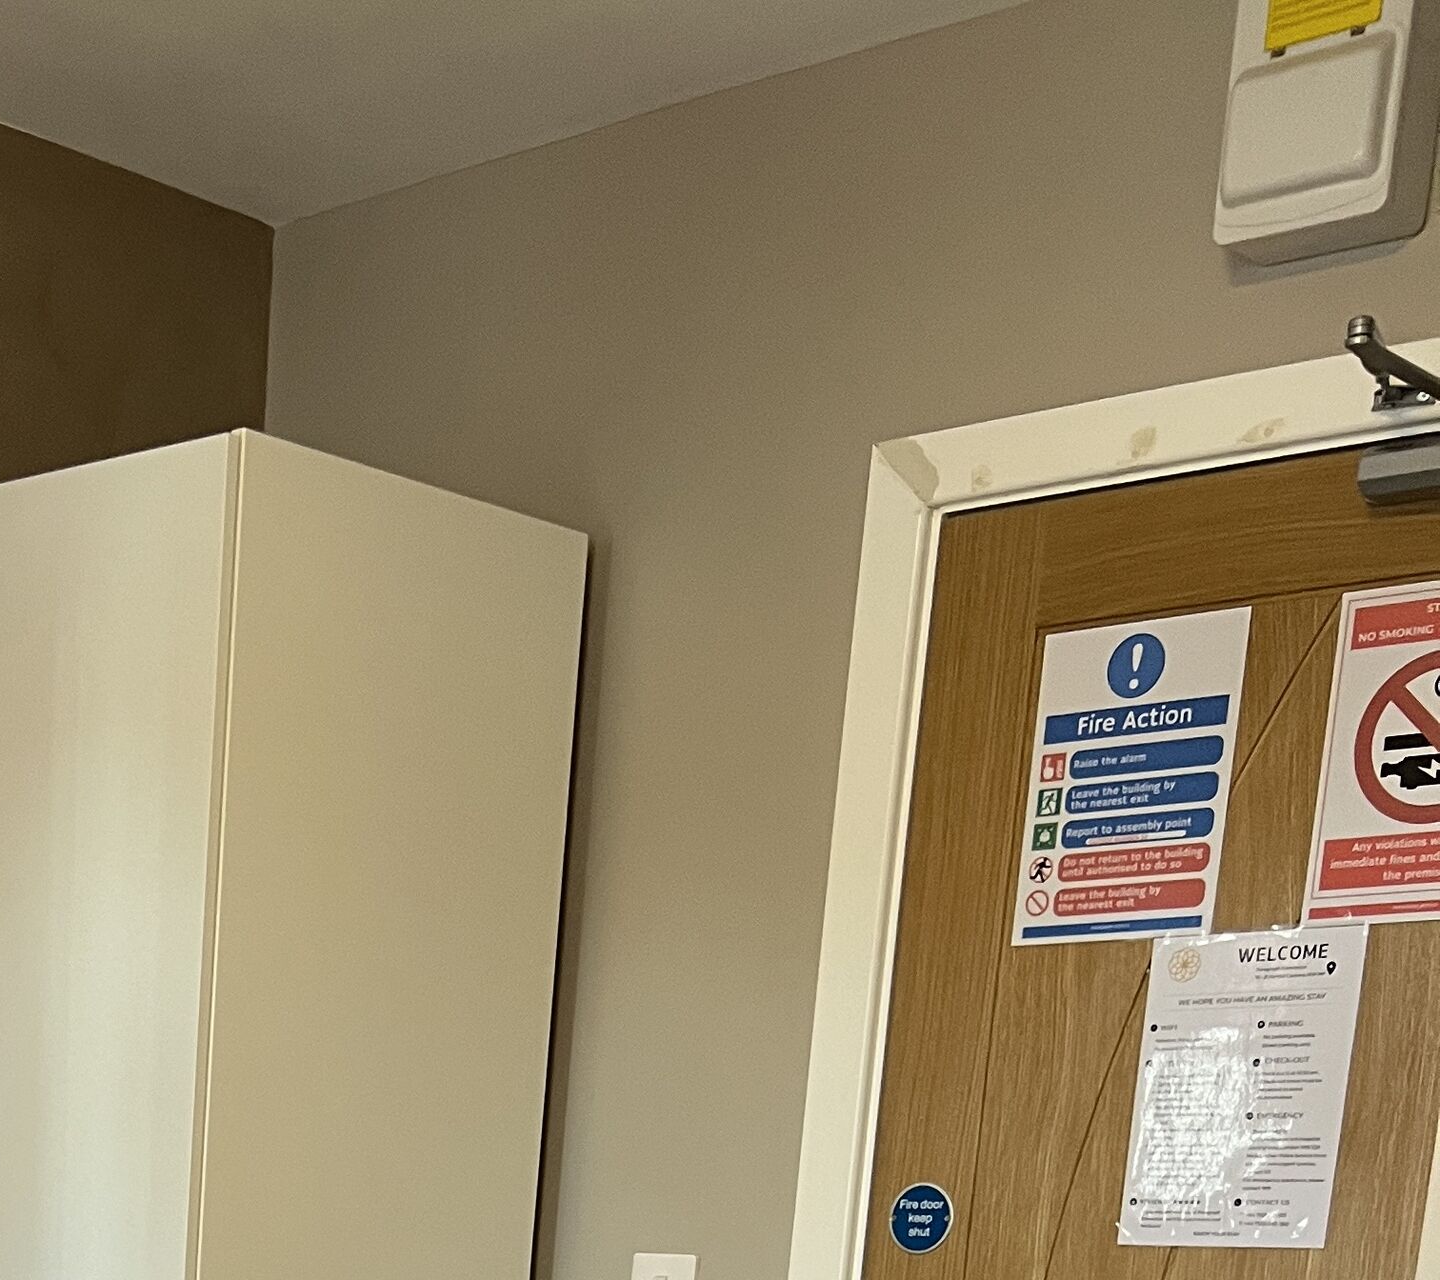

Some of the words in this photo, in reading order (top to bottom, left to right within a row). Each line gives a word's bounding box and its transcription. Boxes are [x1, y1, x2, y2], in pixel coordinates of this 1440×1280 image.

[1358, 631, 1377, 642] NO
[1379, 624, 1435, 640] SMOKING
[1077, 713, 1116, 736] Fire
[1122, 704, 1193, 730] Action
[1073, 759, 1099, 769] Raise
[1101, 756, 1118, 766] the
[1120, 753, 1147, 764] alarm
[1071, 789, 1100, 800] Leave
[1102, 786, 1119, 796] the
[1121, 782, 1160, 795] building
[1163, 780, 1176, 791] by
[1070, 800, 1088, 810] the
[1089, 795, 1128, 808] nearest
[1129, 793, 1150, 804] exit
[1065, 826, 1098, 838] Report
[1101, 825, 1113, 835] to
[1115, 818, 1163, 834] assembly
[1164, 816, 1193, 830] point
[1352, 842, 1374, 853] Any
[1375, 838, 1427, 850] violations
[1063, 857, 1077, 868] Do
[1079, 855, 1096, 866] not
[1098, 853, 1128, 864] return
[1130, 852, 1141, 861] to
[1144, 850, 1162, 860] the
[1164, 846, 1205, 860] building
[1329, 856, 1388, 870] immediate
[1389, 853, 1416, 865] fines
[1086, 862, 1138, 876] authorised
[1140, 862, 1152, 871] to
[1154, 860, 1167, 870] do
[1169, 860, 1182, 869] so
[1382, 870, 1402, 881] the
[1059, 891, 1086, 902] Leave
[1088, 888, 1106, 900] the
[1107, 886, 1146, 899] building
[1148, 885, 1161, 897] by
[1057, 902, 1074, 912] the
[1076, 899, 1113, 911] nearest
[1115, 897, 1135, 908] exit
[1238, 943, 1329, 963] WELCOME
[1268, 993, 1306, 1002] AMAZING
[1307, 992, 1327, 1000] STAY
[1268, 1020, 1304, 1028] PARKING
[899, 1199, 919, 1210] Fire
[920, 1199, 944, 1210] door
[907, 1212, 933, 1225] keep
[908, 1227, 930, 1237] shut
